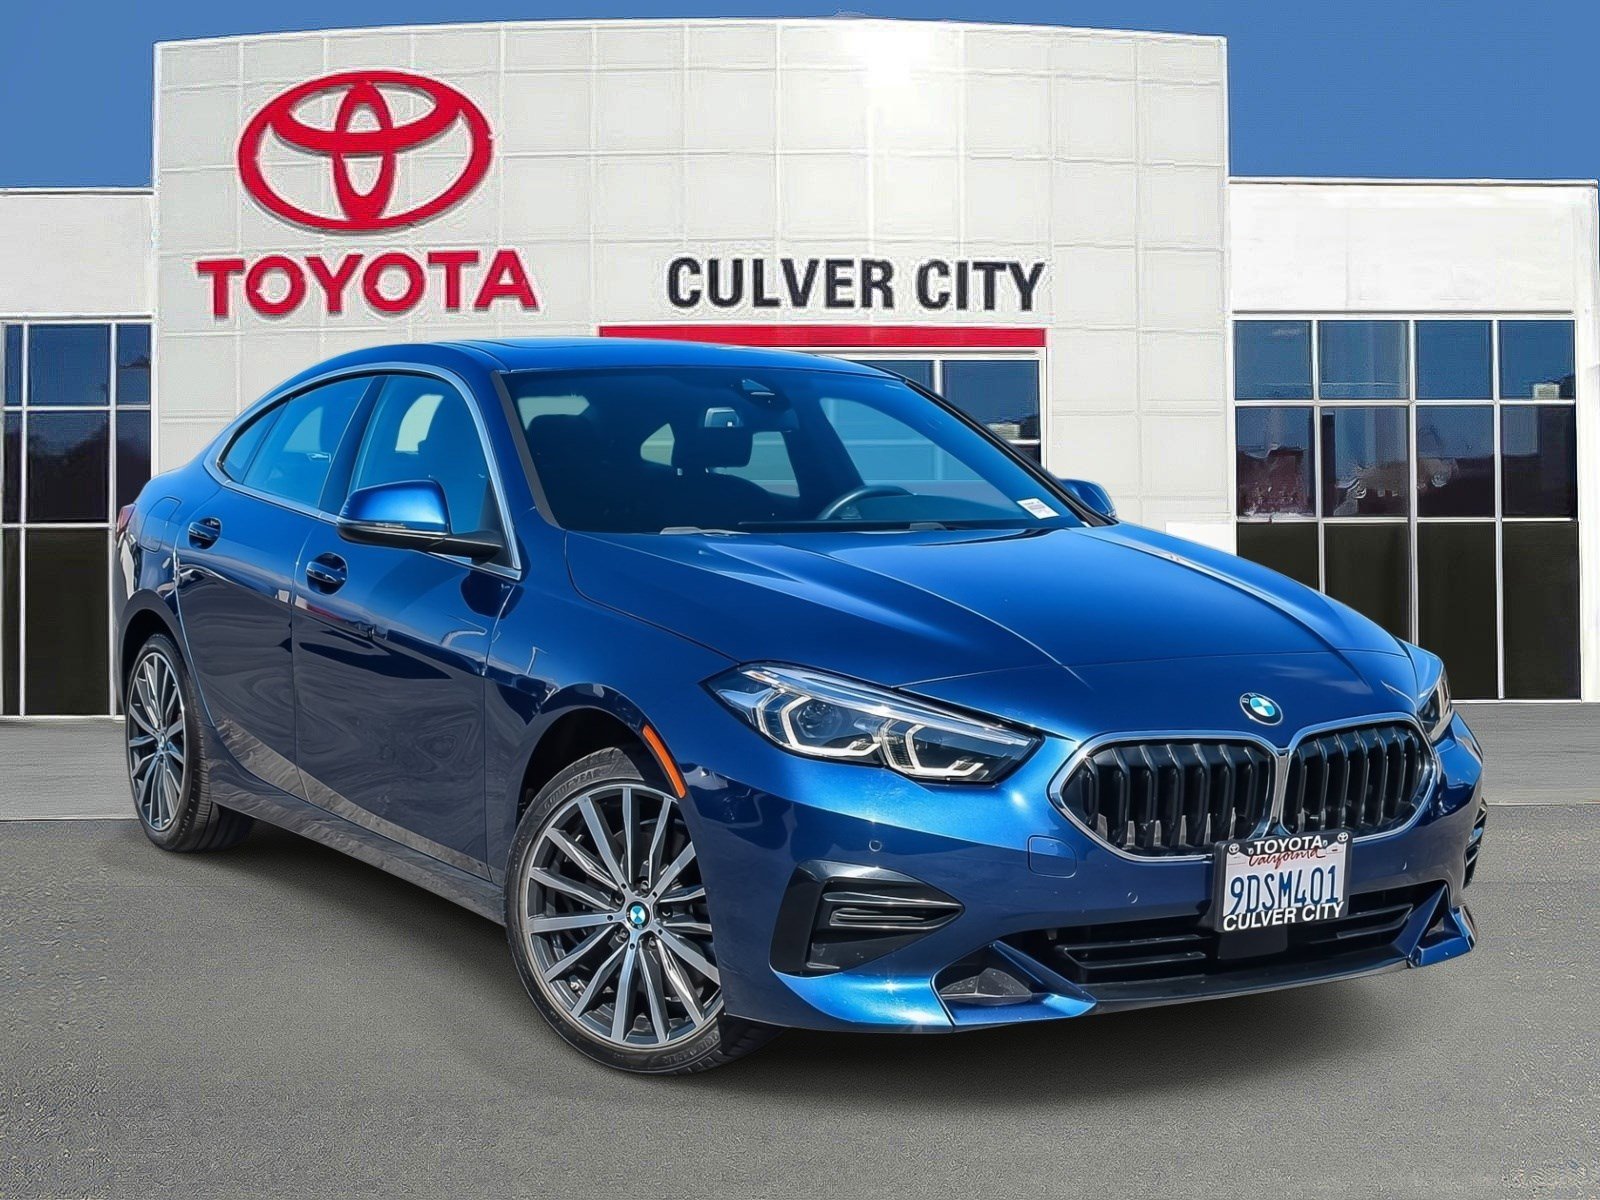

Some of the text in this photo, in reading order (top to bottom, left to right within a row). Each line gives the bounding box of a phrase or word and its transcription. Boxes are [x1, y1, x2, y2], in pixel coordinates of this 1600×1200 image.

[196, 250, 539, 318] TOYOTA
[668, 256, 1045, 311] CULVER CITY
[1254, 835, 1322, 855] TOYOTA
[1230, 865, 1338, 915] 9DSM401
[1223, 901, 1344, 931] CULVER CITY
